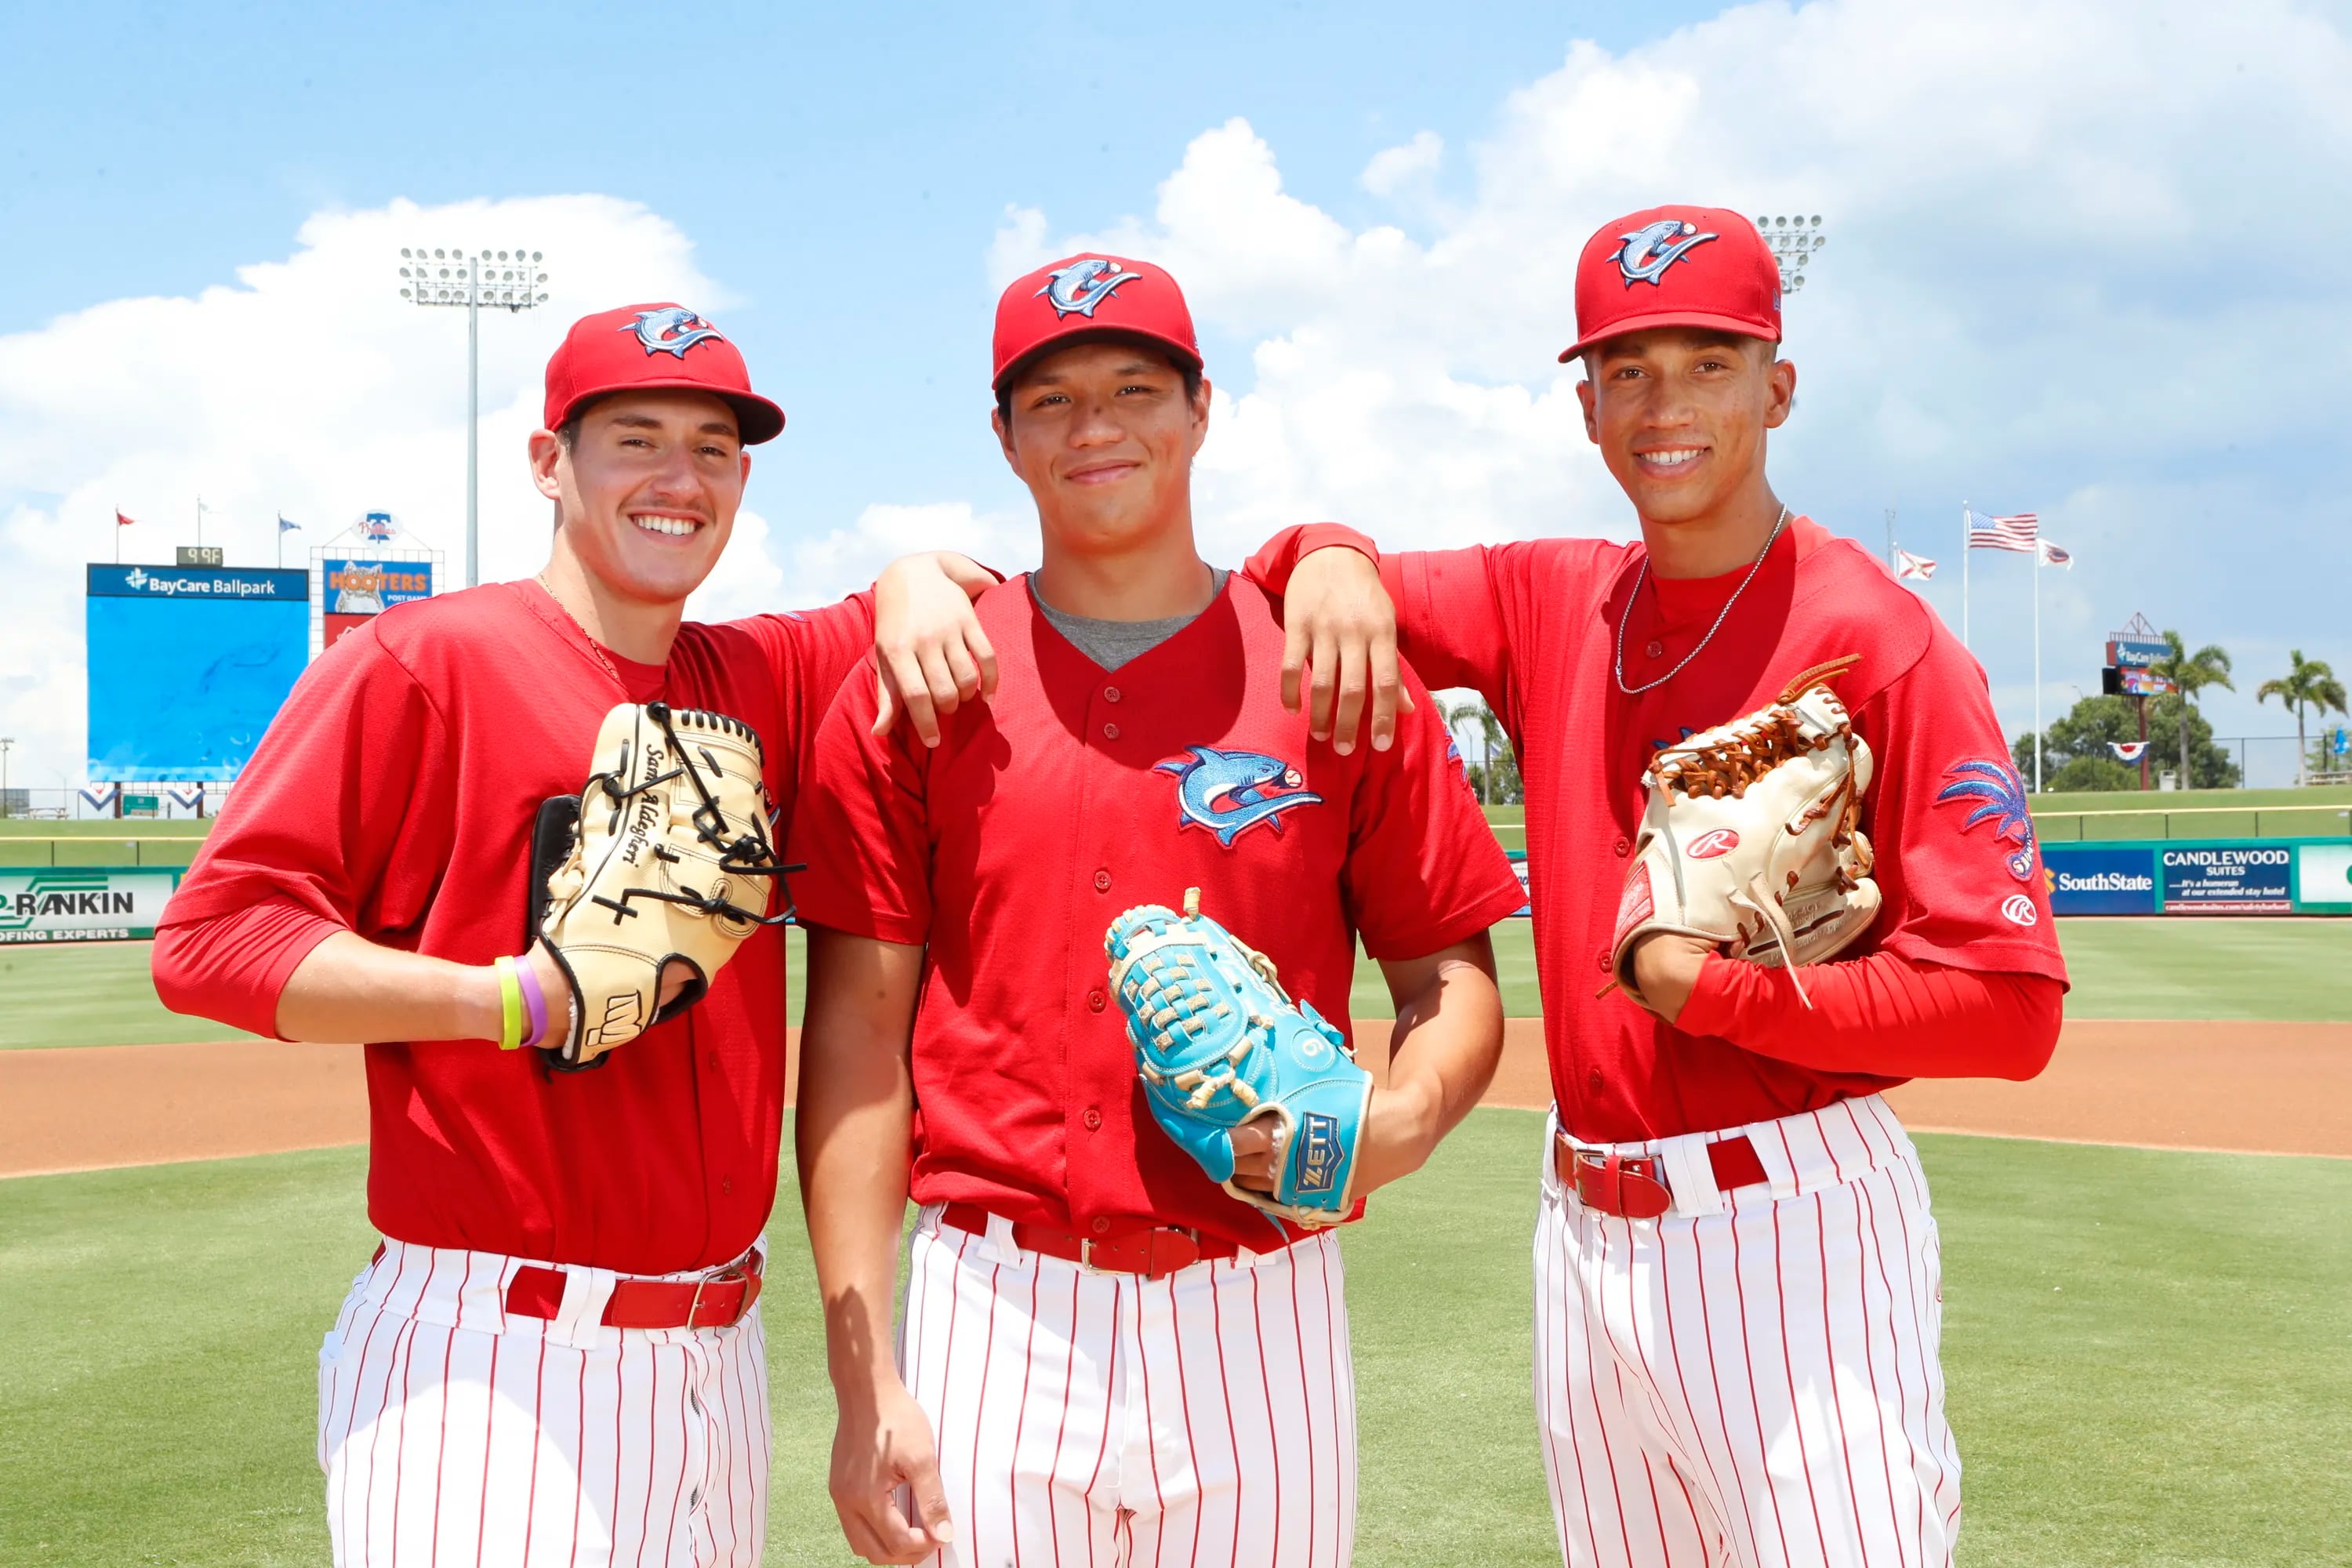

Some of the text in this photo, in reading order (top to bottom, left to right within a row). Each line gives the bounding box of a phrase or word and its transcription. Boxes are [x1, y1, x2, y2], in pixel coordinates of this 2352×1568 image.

[150, 579, 275, 597] BayCare Ballpark
[329, 572, 426, 591] HOOTERS
[2163, 851, 2289, 866] CANDLEWOOD
[2206, 866, 2245, 876] SUITES
[2059, 873, 2153, 891] SouthState
[2207, 887, 2244, 895] extended
[2245, 888, 2262, 898] stay
[2263, 887, 2285, 895] hotel
[53, 928, 129, 939] EXPERTS
[1304, 1116, 1327, 1187] ZETT
